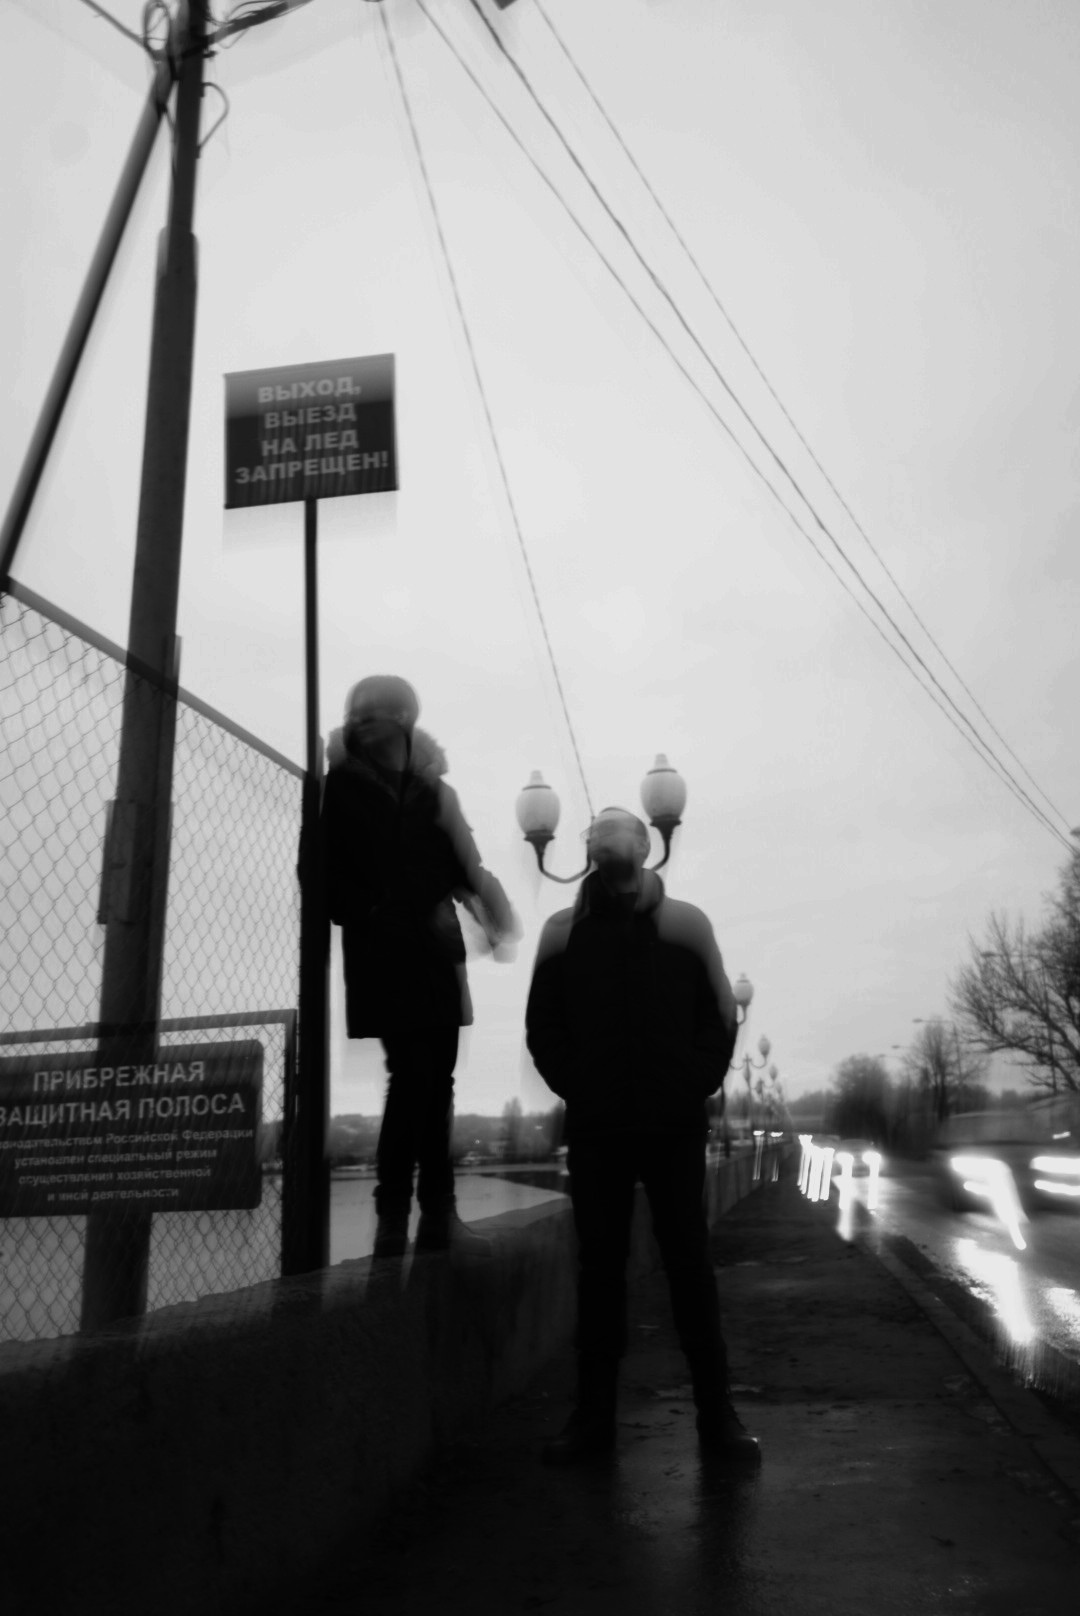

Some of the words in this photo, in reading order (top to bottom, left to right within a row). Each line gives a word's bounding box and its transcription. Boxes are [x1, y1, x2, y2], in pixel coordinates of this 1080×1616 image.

[257, 376, 361, 403] ВЫХОД,
[264, 402, 357, 429] ВЫЕЗД
[261, 437, 297, 456] НА
[304, 429, 359, 450] ЛЕД
[235, 451, 388, 484] ЗАПРЕЩЕН!
[33, 1061, 206, 1092] ПРИБРЕЖНАЯ
[138, 1092, 245, 1119] ПОЛОСА
[105, 1129, 178, 1145] Российской
[182, 1129, 253, 1143] Федерации
[14, 1154, 85, 1169] установлен
[87, 1148, 172, 1164] специальный
[176, 1149, 217, 1162] режим
[116, 1166, 211, 1182] хозяйственной
